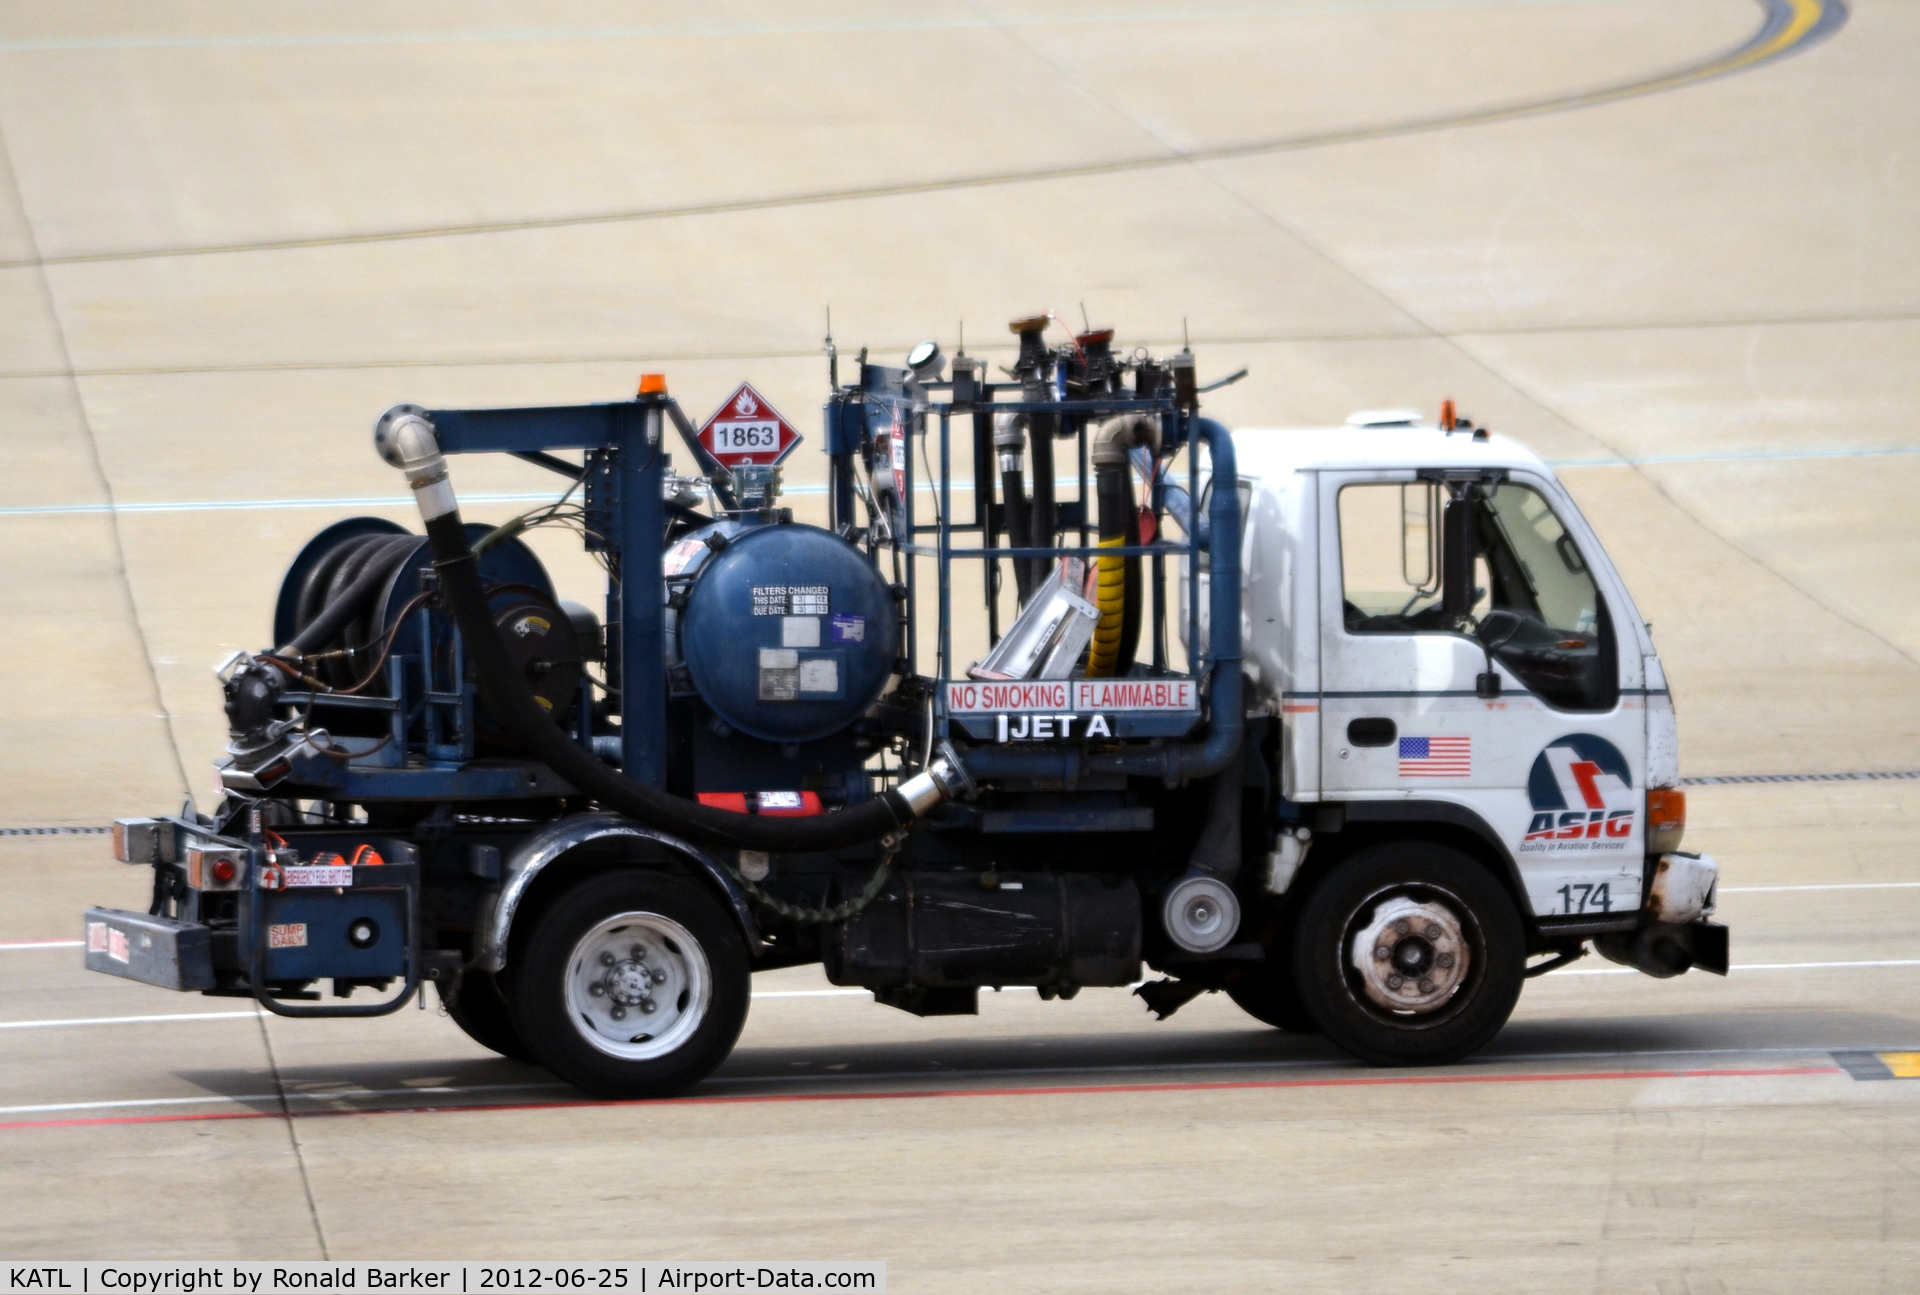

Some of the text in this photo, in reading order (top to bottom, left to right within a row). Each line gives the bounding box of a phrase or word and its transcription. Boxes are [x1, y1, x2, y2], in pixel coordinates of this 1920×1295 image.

[719, 426, 774, 447] 1863
[754, 587, 828, 595] FILTERS CHANGED
[754, 597, 768, 605] THIS
[769, 596, 788, 604] DATE:
[754, 607, 767, 615] DUE
[769, 606, 788, 615] DATE:
[951, 685, 1065, 709] NO SMOKING
[1080, 683, 1189, 708] FLAMMABLE
[1011, 715, 1112, 738] JET A
[1523, 810, 1635, 841] ASIG
[1519, 840, 1625, 852] Quality in Aviation Services
[316, 869, 328, 885] FUEL
[342, 869, 352, 884] OFF
[1556, 883, 1613, 914] 174
[271, 924, 303, 936] SUMP
[272, 935, 304, 946] DAILY
